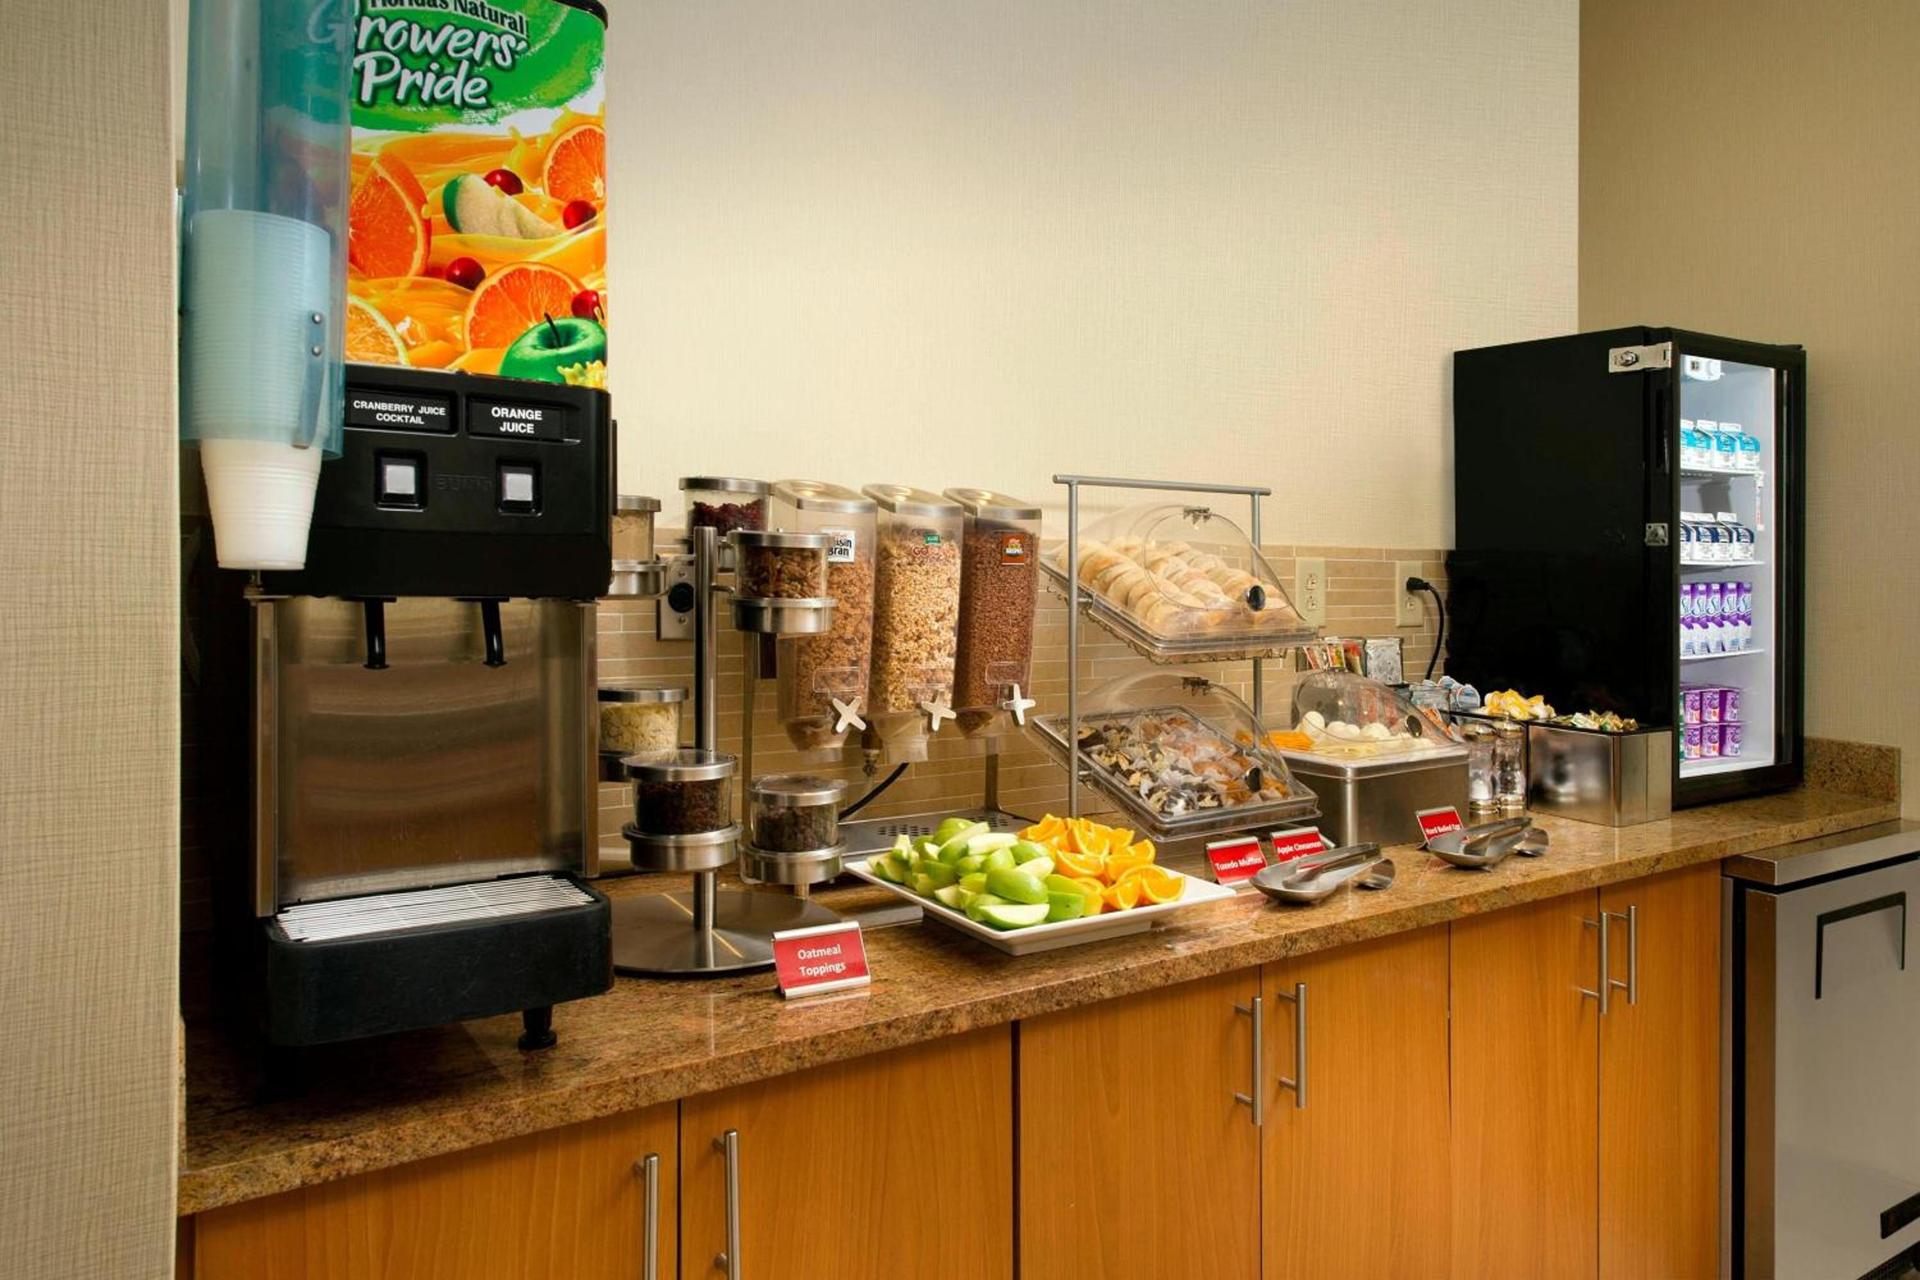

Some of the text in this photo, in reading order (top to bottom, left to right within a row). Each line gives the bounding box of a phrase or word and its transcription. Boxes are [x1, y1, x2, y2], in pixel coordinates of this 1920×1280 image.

[453, 0, 525, 35] Natural
[353, 51, 488, 107] Pride
[353, 400, 446, 416] CRANBERRY JUICE
[491, 407, 543, 421] ORANGE
[376, 413, 424, 425] COCKTAIL
[499, 422, 535, 434] JUICE
[1277, 844, 1294, 855] Apple
[798, 944, 841, 959] Oatmeal
[799, 962, 846, 977] Toppings
